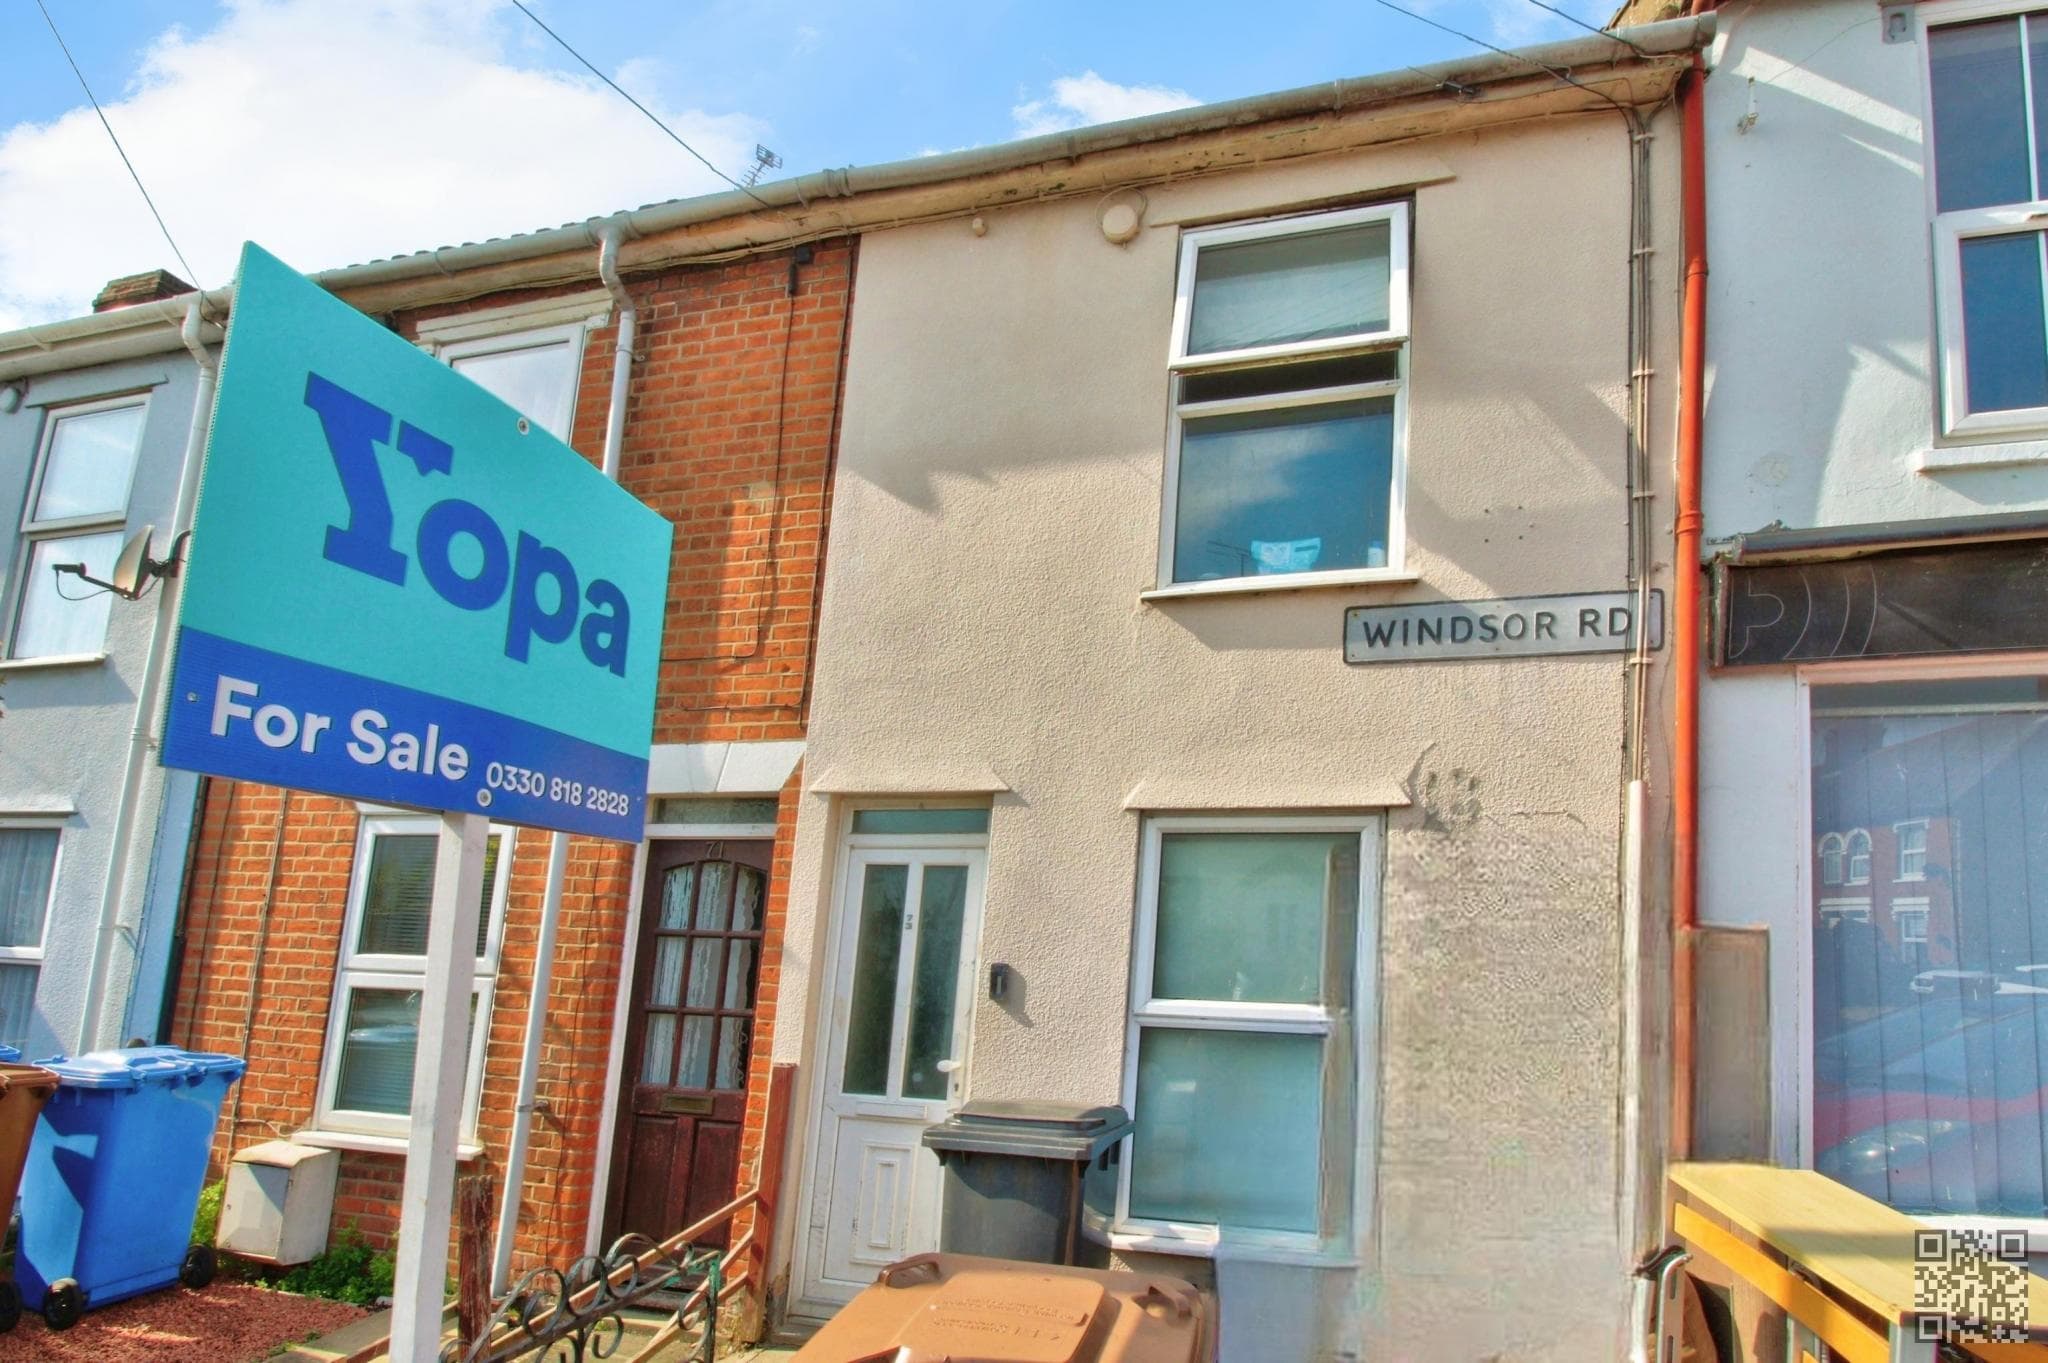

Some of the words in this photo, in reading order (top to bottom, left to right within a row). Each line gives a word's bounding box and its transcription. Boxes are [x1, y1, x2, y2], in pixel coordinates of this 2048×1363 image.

[303, 370, 631, 678] Yopa
[1362, 611, 1557, 648] WINDSOR
[1578, 606, 1633, 638] RD
[209, 674, 332, 754] For
[345, 708, 470, 783] Sale
[485, 761, 546, 798] 0330
[550, 776, 583, 807] 818
[585, 786, 630, 817] 2828
